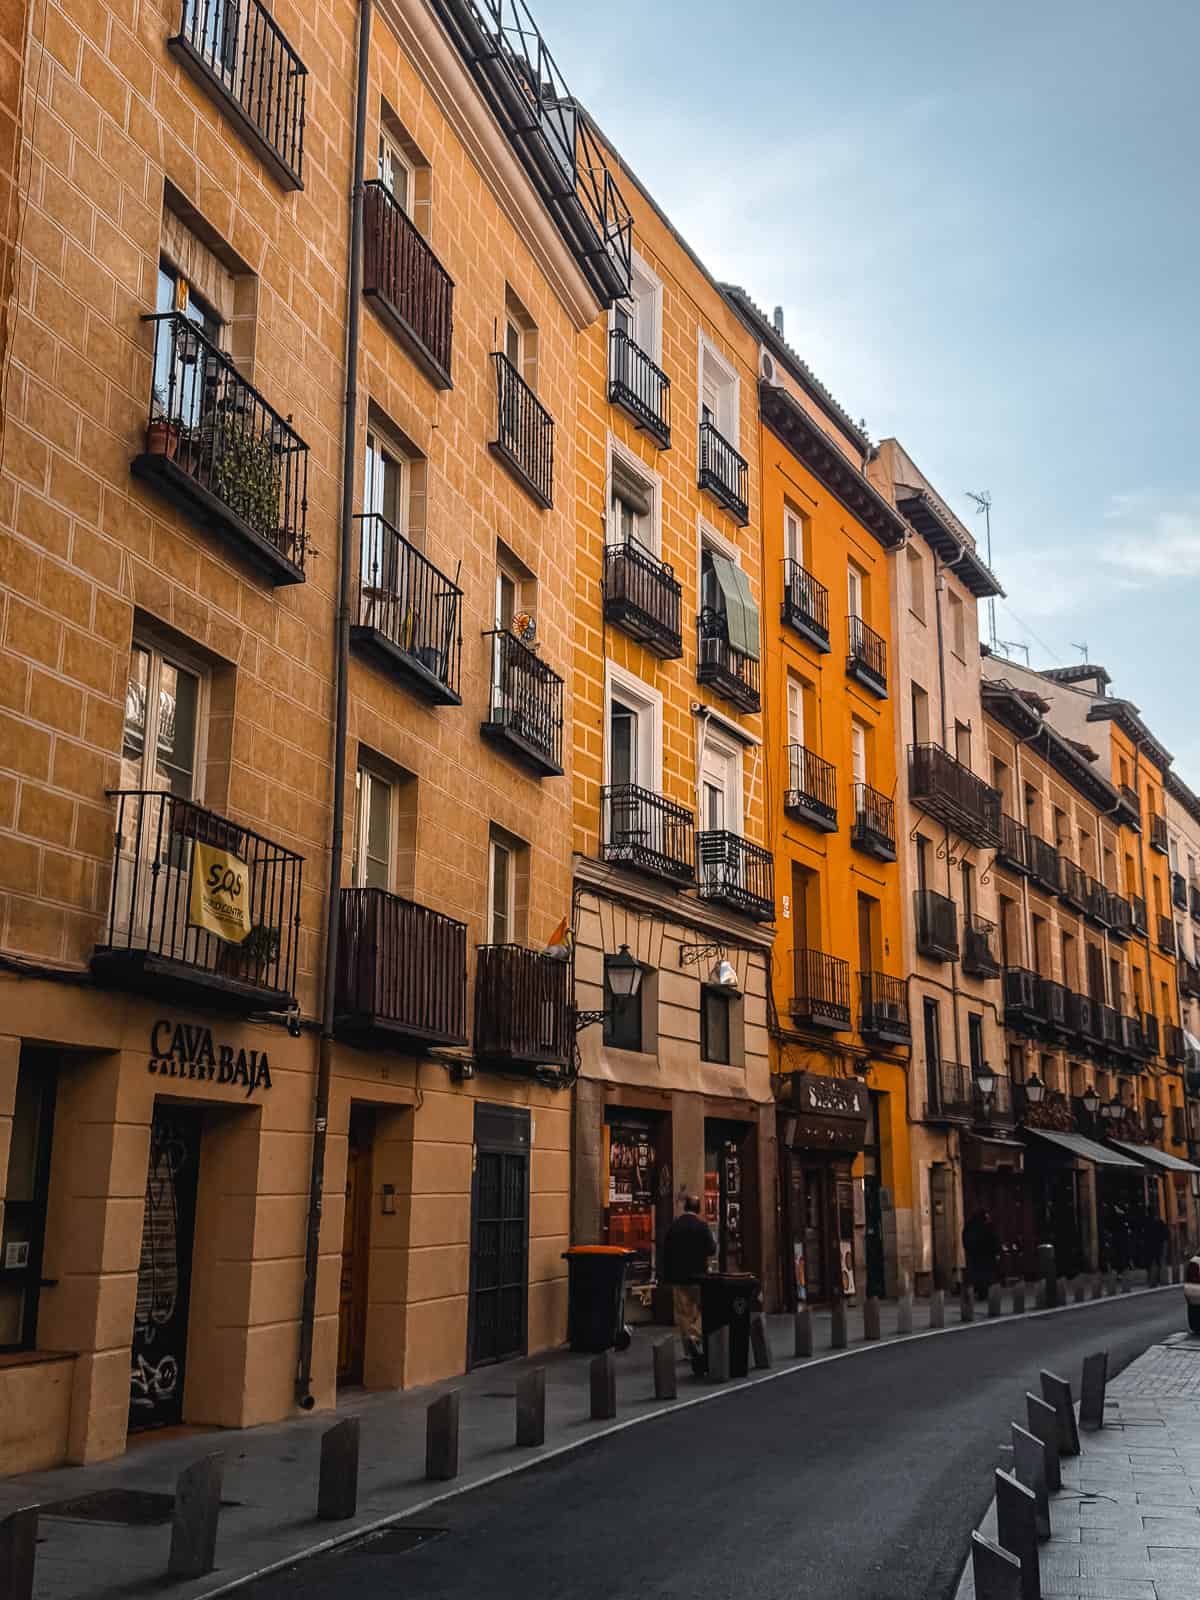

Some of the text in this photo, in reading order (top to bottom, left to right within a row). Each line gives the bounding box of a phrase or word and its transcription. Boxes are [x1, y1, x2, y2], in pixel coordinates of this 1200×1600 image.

[148, 1059, 217, 1080] GALLERY
[151, 1020, 272, 1098] CAVA BAJA
